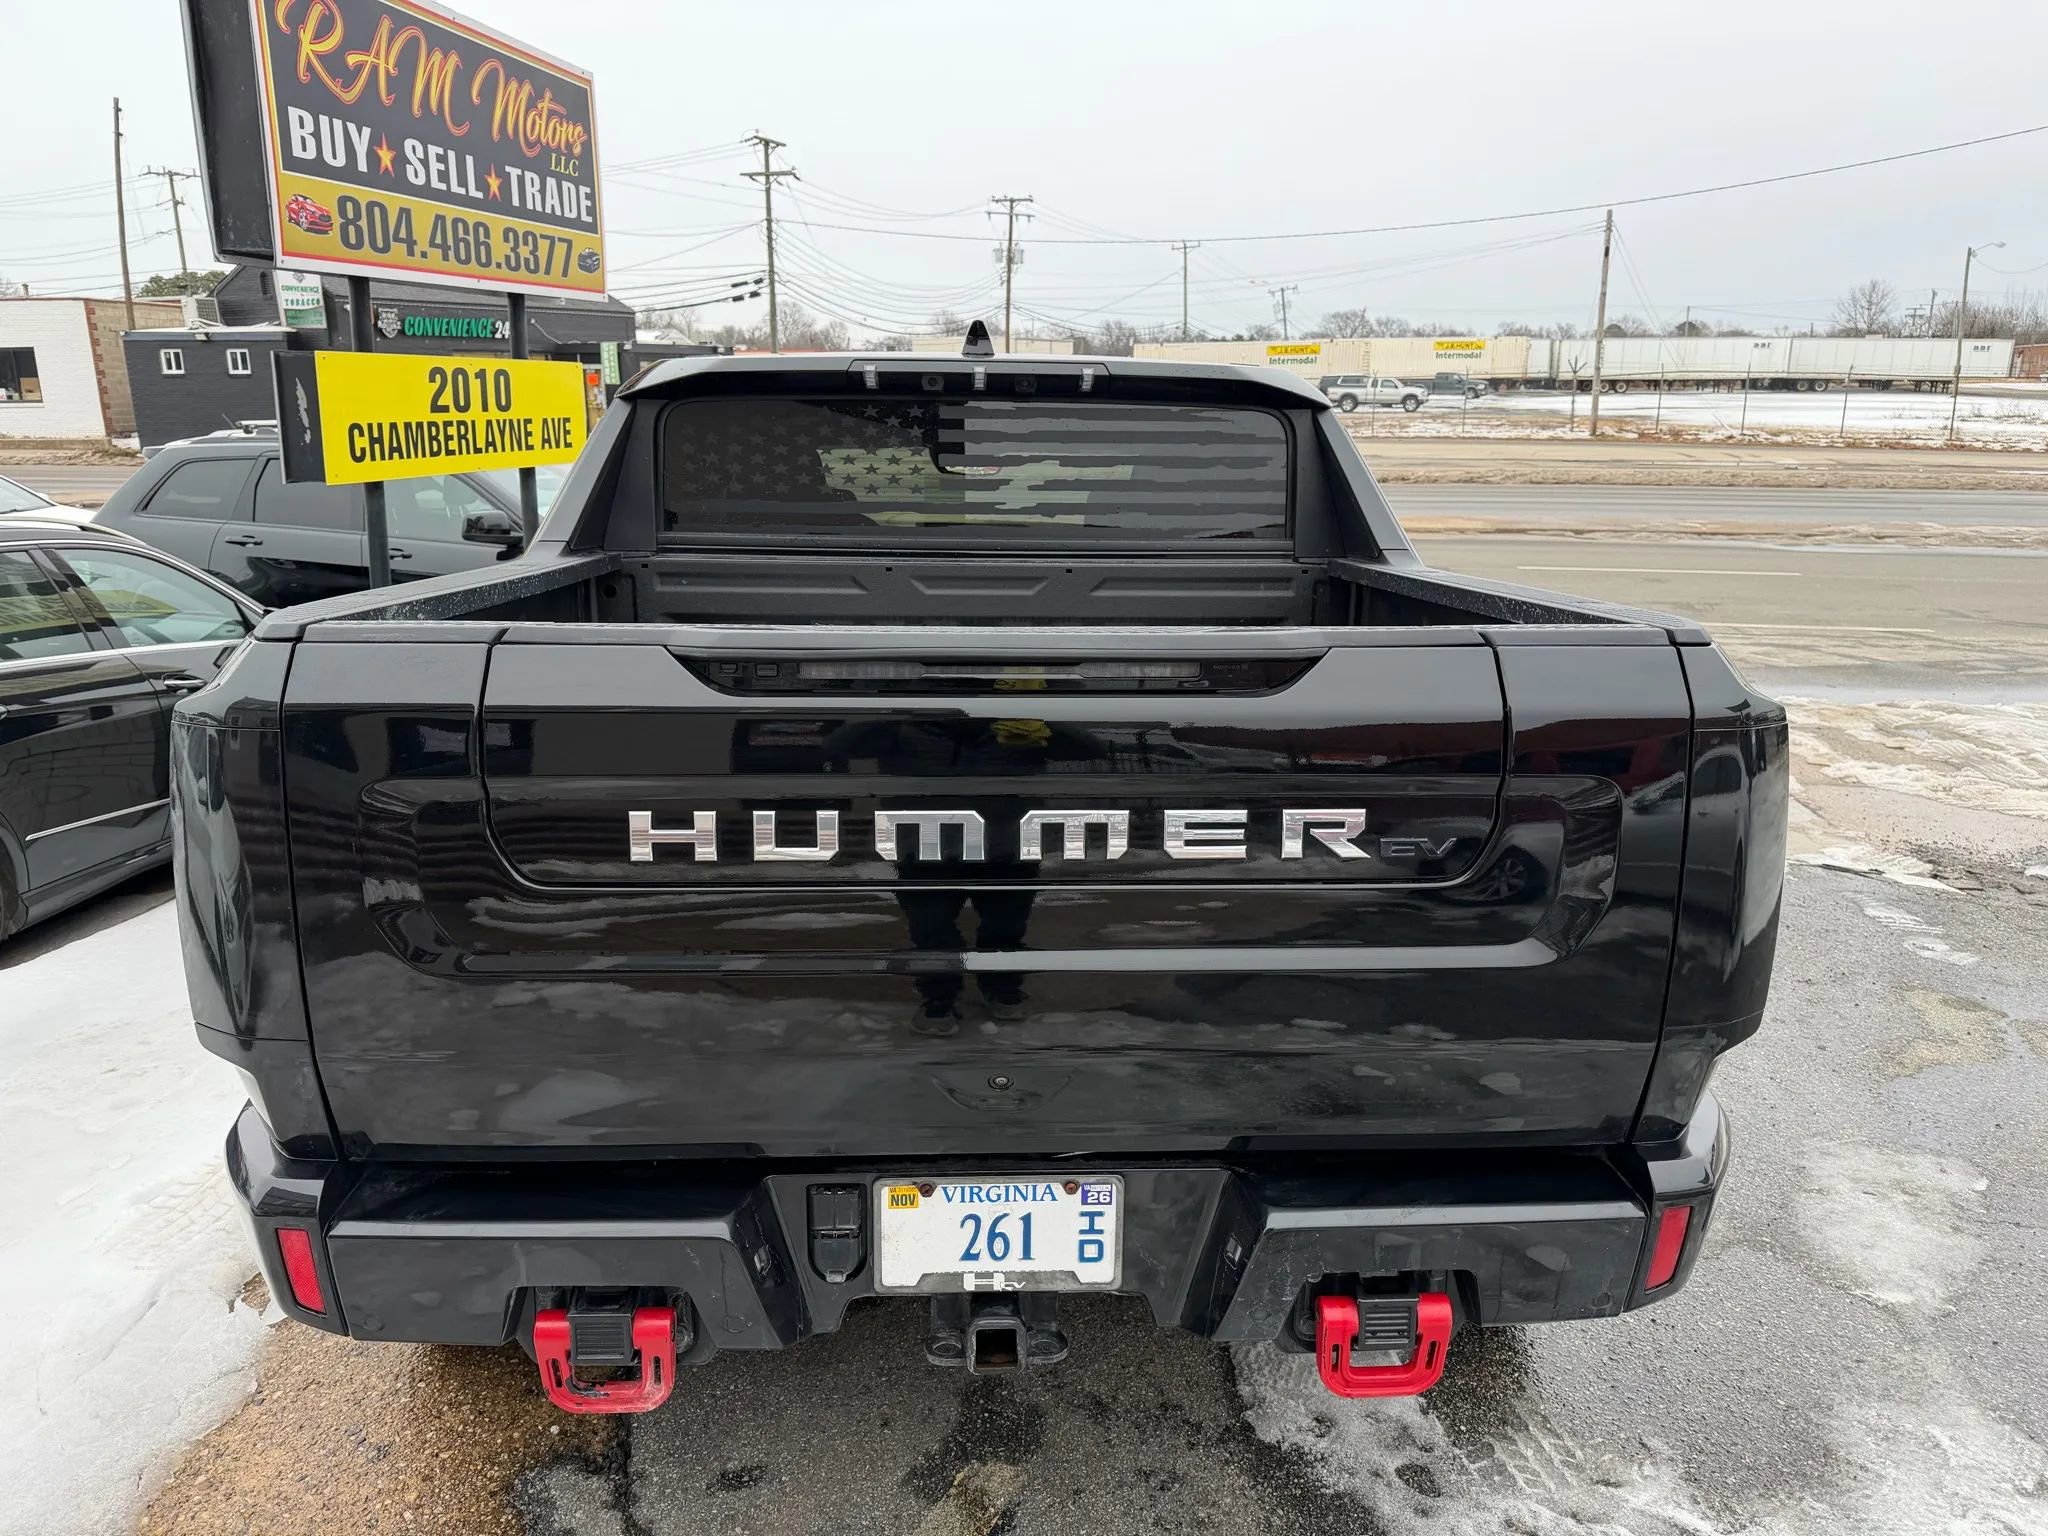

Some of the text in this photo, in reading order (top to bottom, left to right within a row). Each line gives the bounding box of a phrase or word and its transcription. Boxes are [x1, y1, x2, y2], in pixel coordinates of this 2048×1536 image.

[274, 0, 588, 157] RAM Motors
[287, 105, 594, 223] BUY SELL TRADE
[550, 152, 579, 177] LLC
[336, 194, 573, 279] 804.466.3377
[285, 298, 321, 306] TOBACCO
[404, 316, 495, 338] CONVENIENCE
[1269, 356, 1317, 365] Intermodal
[1435, 351, 1482, 360] Intermodal
[428, 366, 512, 414] 2010
[347, 416, 573, 464] CHAMBERLAYNE AVE
[628, 809, 1457, 862] HUMMER EV
[890, 1193, 917, 1206] NOV
[941, 1183, 1059, 1203] VIRGINIA
[1087, 1191, 1111, 1203] 26
[958, 1211, 1037, 1261] 261
